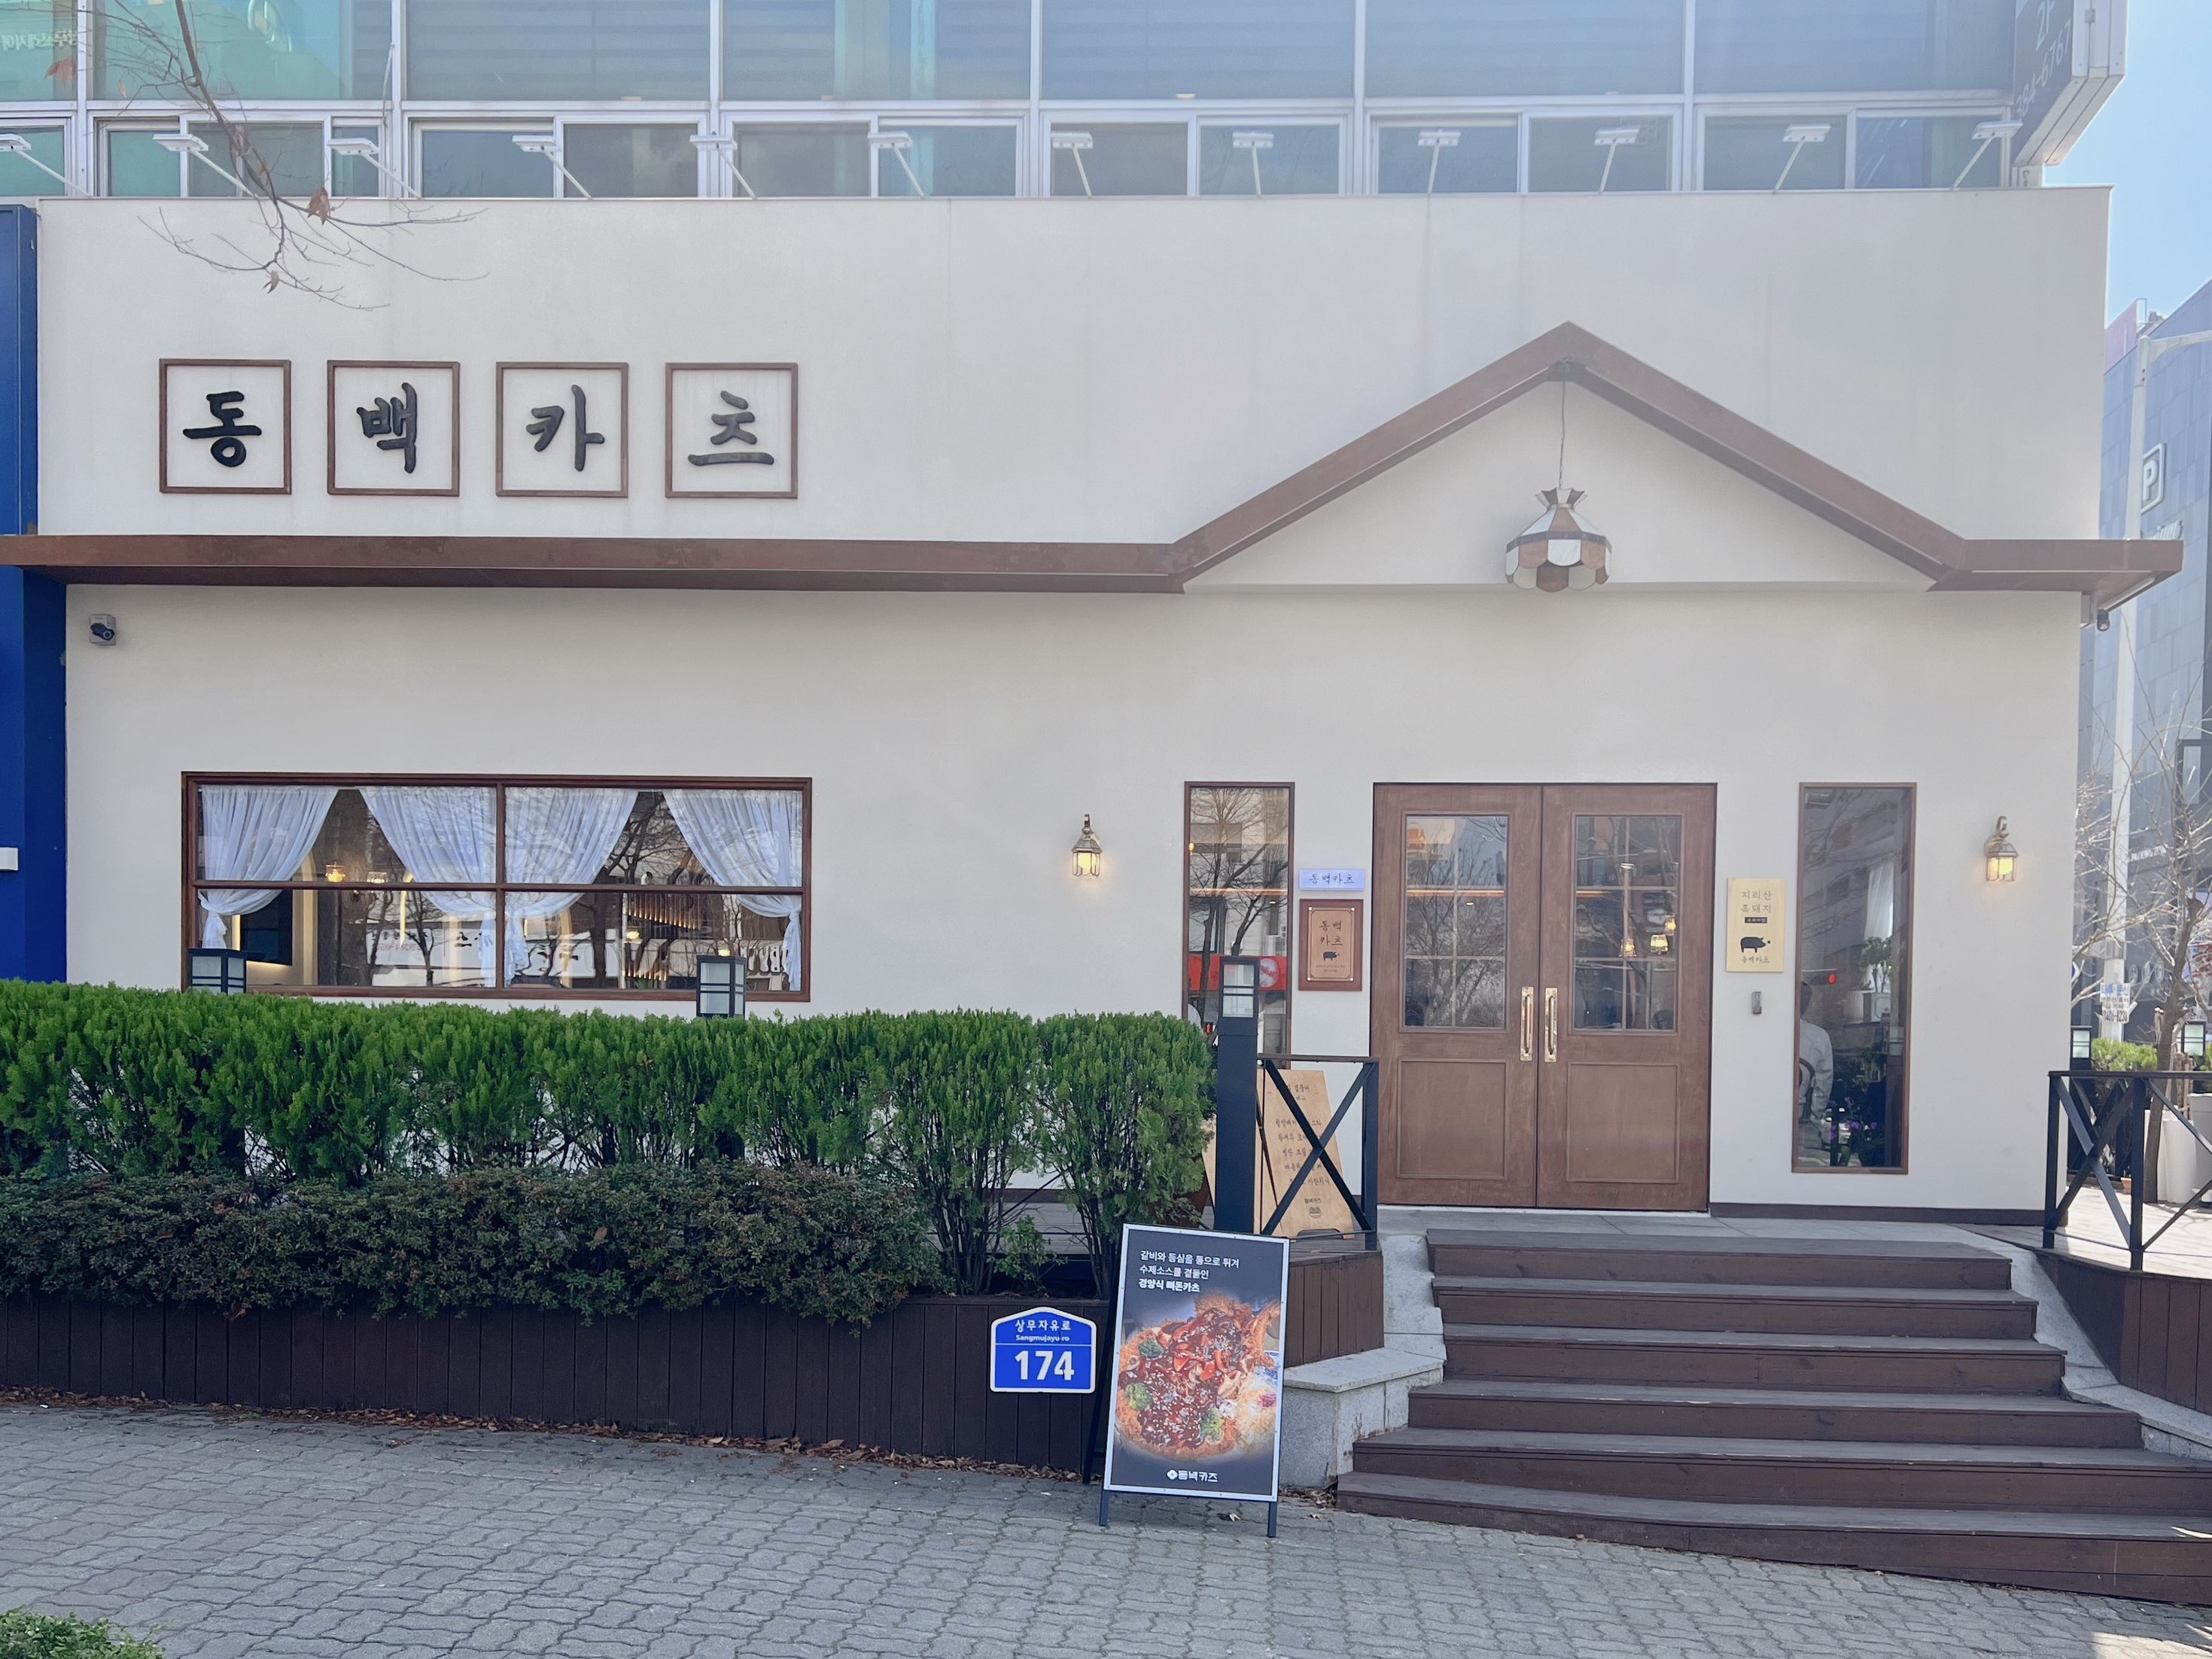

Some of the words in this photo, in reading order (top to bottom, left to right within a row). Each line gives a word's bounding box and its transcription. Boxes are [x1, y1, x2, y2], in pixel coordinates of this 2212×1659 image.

[183, 382, 774, 473] 동백카츠
[1309, 873, 1355, 884] 동백카츠
[1742, 890, 1772, 900] 지리산
[1741, 904, 1771, 913] 흑돼지
[1319, 920, 1342, 932] 동백
[1319, 935, 1343, 946] 카츠
[1140, 1250, 1166, 1262] 갈비와
[1168, 1253, 1193, 1264] 등심을
[1195, 1256, 1220, 1266] 통으로
[1222, 1258, 1240, 1268] 튀겨
[1139, 1265, 1182, 1277] 수제소스를
[1184, 1268, 1209, 1280] 곁들인
[1138, 1278, 1164, 1290] 경양식
[1015, 1320, 1071, 1333] 상무자유로
[1015, 1350, 1075, 1380] 174
